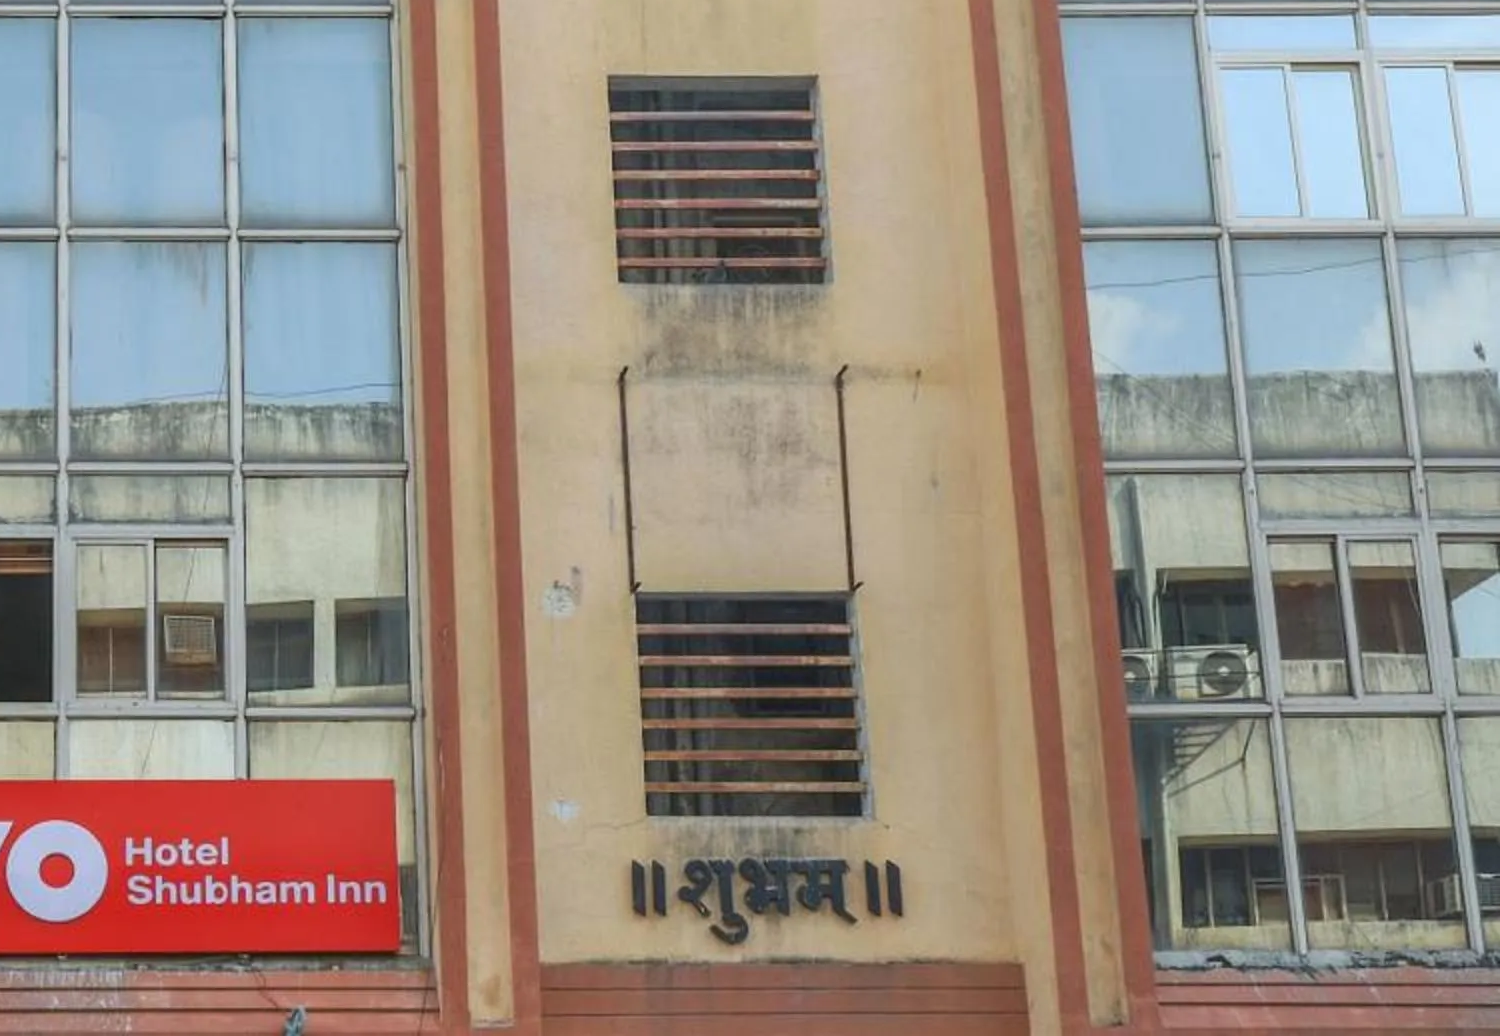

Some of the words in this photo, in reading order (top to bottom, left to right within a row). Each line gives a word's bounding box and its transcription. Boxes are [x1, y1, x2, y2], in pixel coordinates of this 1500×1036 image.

[125, 836, 230, 866] Hotel
[126, 873, 316, 905] Shubham
[326, 873, 387, 904] Inn
